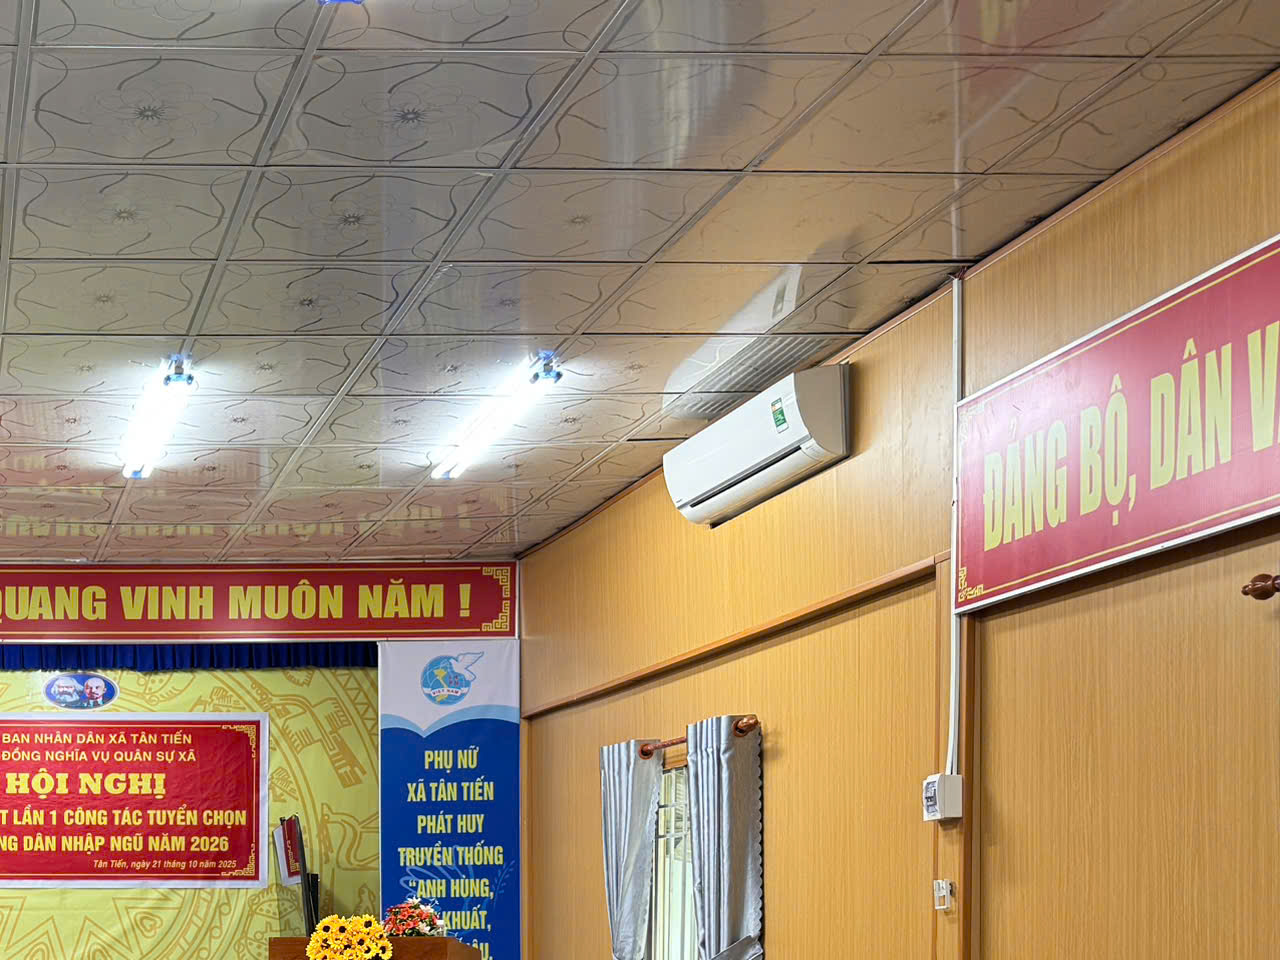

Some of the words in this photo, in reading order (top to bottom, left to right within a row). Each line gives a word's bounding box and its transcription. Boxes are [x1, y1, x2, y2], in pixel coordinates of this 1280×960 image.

[983, 416, 1067, 552] ĐẢNG
[1080, 373, 1137, 526] BỘ,
[1150, 338, 1232, 490] DÂN
[1247, 320, 1280, 452] V
[120, 585, 214, 621] VINH
[229, 578, 345, 621] MUÔN
[358, 577, 446, 619] NĂM
[459, 583, 472, 617] !
[2, 733, 31, 744] BAN
[34, 731, 72, 744] NHÂN
[77, 731, 104, 744] DÂN
[108, 731, 127, 744] XÃ
[130, 731, 158, 745] TÂN
[161, 729, 192, 744] TIẾN
[1, 746, 41, 763] ĐỒNG
[45, 749, 88, 762] NGHĨA
[91, 751, 110, 765] VỤ
[114, 749, 153, 763] QUÂN
[156, 749, 176, 764] SỰ
[178, 749, 196, 762] XÃ
[425, 750, 454, 773] PHỤ
[457, 745, 480, 769] NỮ
[5, 768, 69, 799] HỘI
[79, 772, 166, 799] NGHỊ
[407, 780, 427, 802] XÃ
[429, 778, 458, 802] TÂN
[461, 776, 495, 801] TIẾN
[13, 804, 46, 825] LẦN
[49, 810, 58, 825] 1
[63, 806, 109, 826] CÔNG
[113, 805, 143, 826] TÁC
[147, 803, 199, 826] TUYỂN
[202, 809, 247, 829] CHỌN
[417, 810, 453, 834] PHÁT
[457, 814, 485, 833] HUY
[23, 832, 57, 852] DÂN
[61, 832, 105, 854] NHẬP
[110, 832, 144, 852] NGŨ
[148, 832, 185, 852] NĂM
[190, 836, 230, 852] 2026
[398, 840, 453, 867] TRUYỀN
[456, 840, 504, 866] THỐNG
[93, 859, 110, 868] Tân
[111, 858, 129, 870] Tiến,
[130, 860, 150, 871] ngày
[152, 860, 162, 868] 21
[163, 859, 186, 871] tháng
[188, 860, 198, 868] 10
[199, 860, 216, 868] năm
[218, 860, 237, 868] 2025
[451, 874, 494, 900] HÙNG,
[442, 904, 491, 932] KHUẤT,
